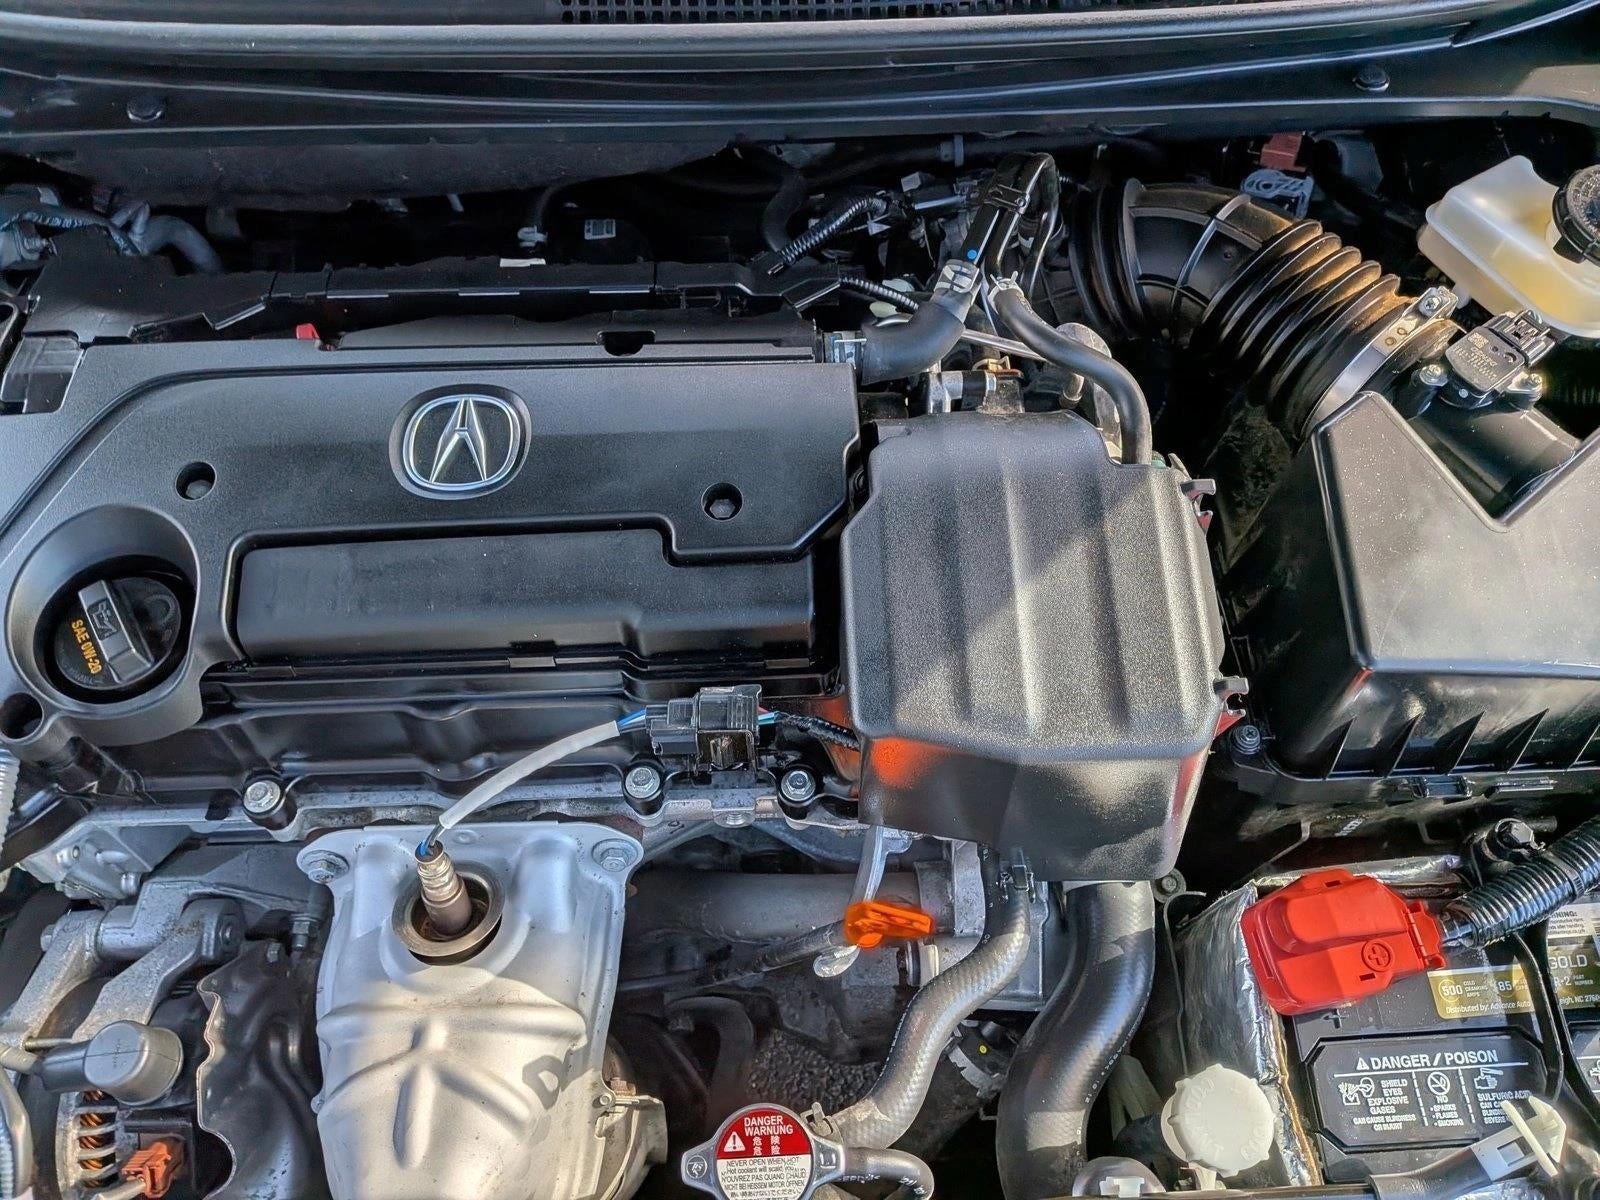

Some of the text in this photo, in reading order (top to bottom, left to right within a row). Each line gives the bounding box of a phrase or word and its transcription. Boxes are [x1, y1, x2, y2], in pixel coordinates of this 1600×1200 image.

[72, 620, 89, 643] SAE
[81, 642, 101, 673] 0W-20
[1549, 955, 1587, 969] GOLD
[1498, 981, 1512, 991] 85
[1442, 986, 1463, 997] 500
[1574, 995, 1584, 1003] NC
[1446, 1004, 1479, 1014] Distributed
[1490, 1001, 1516, 1010] Advance
[1517, 1000, 1531, 1008] Auto
[1370, 1054, 1431, 1070] DANGER
[1444, 1050, 1498, 1065] POISON
[1380, 1078, 1408, 1088] SHIELD
[1382, 1087, 1403, 1096] EYES
[1477, 1090, 1531, 1101] SULFURIC ACID
[1367, 1096, 1409, 1106] EXPLOSIVE
[1436, 1096, 1448, 1104] NO
[1369, 1105, 1396, 1115] GASES
[744, 1116, 783, 1126] DANGER
[1366, 1116, 1385, 1124] CAUSE
[1385, 1114, 1417, 1123] BLINDNESS
[1484, 1116, 1506, 1124] SEVERE
[745, 1125, 793, 1136] WARNUNG
[1383, 1122, 1402, 1131] INJURY
[726, 1156, 799, 1168] NEVER OPEN WHEN HOT
[752, 1173, 763, 1181] PAS
[764, 1172, 784, 1181] QUAND
[768, 1180, 786, 1188] MOTOR
